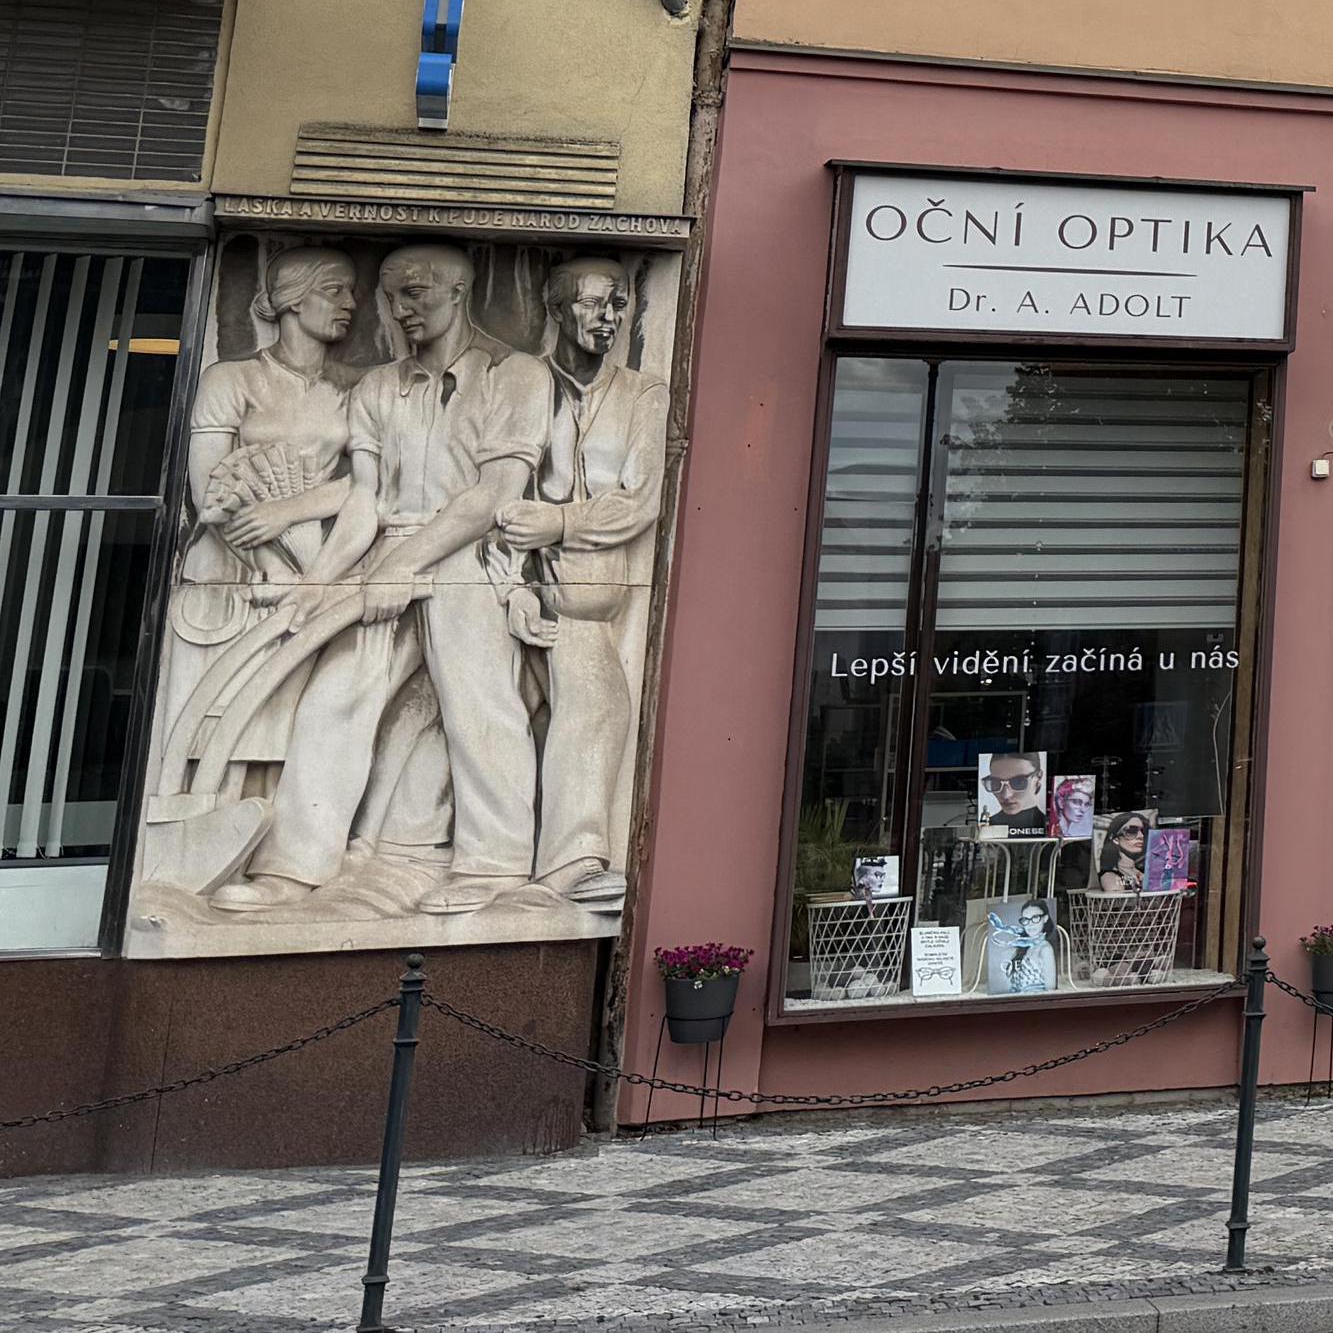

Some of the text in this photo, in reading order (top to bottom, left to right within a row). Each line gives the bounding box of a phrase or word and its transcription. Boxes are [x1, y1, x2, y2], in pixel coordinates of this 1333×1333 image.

[300, 203, 312, 218] A
[428, 208, 440, 223] K
[865, 199, 1274, 259] OČNÍ OPTIKA
[948, 287, 1192, 319] Dr. A. ADOLT
[831, 645, 1239, 685] Lepší vidění začíná u nás
